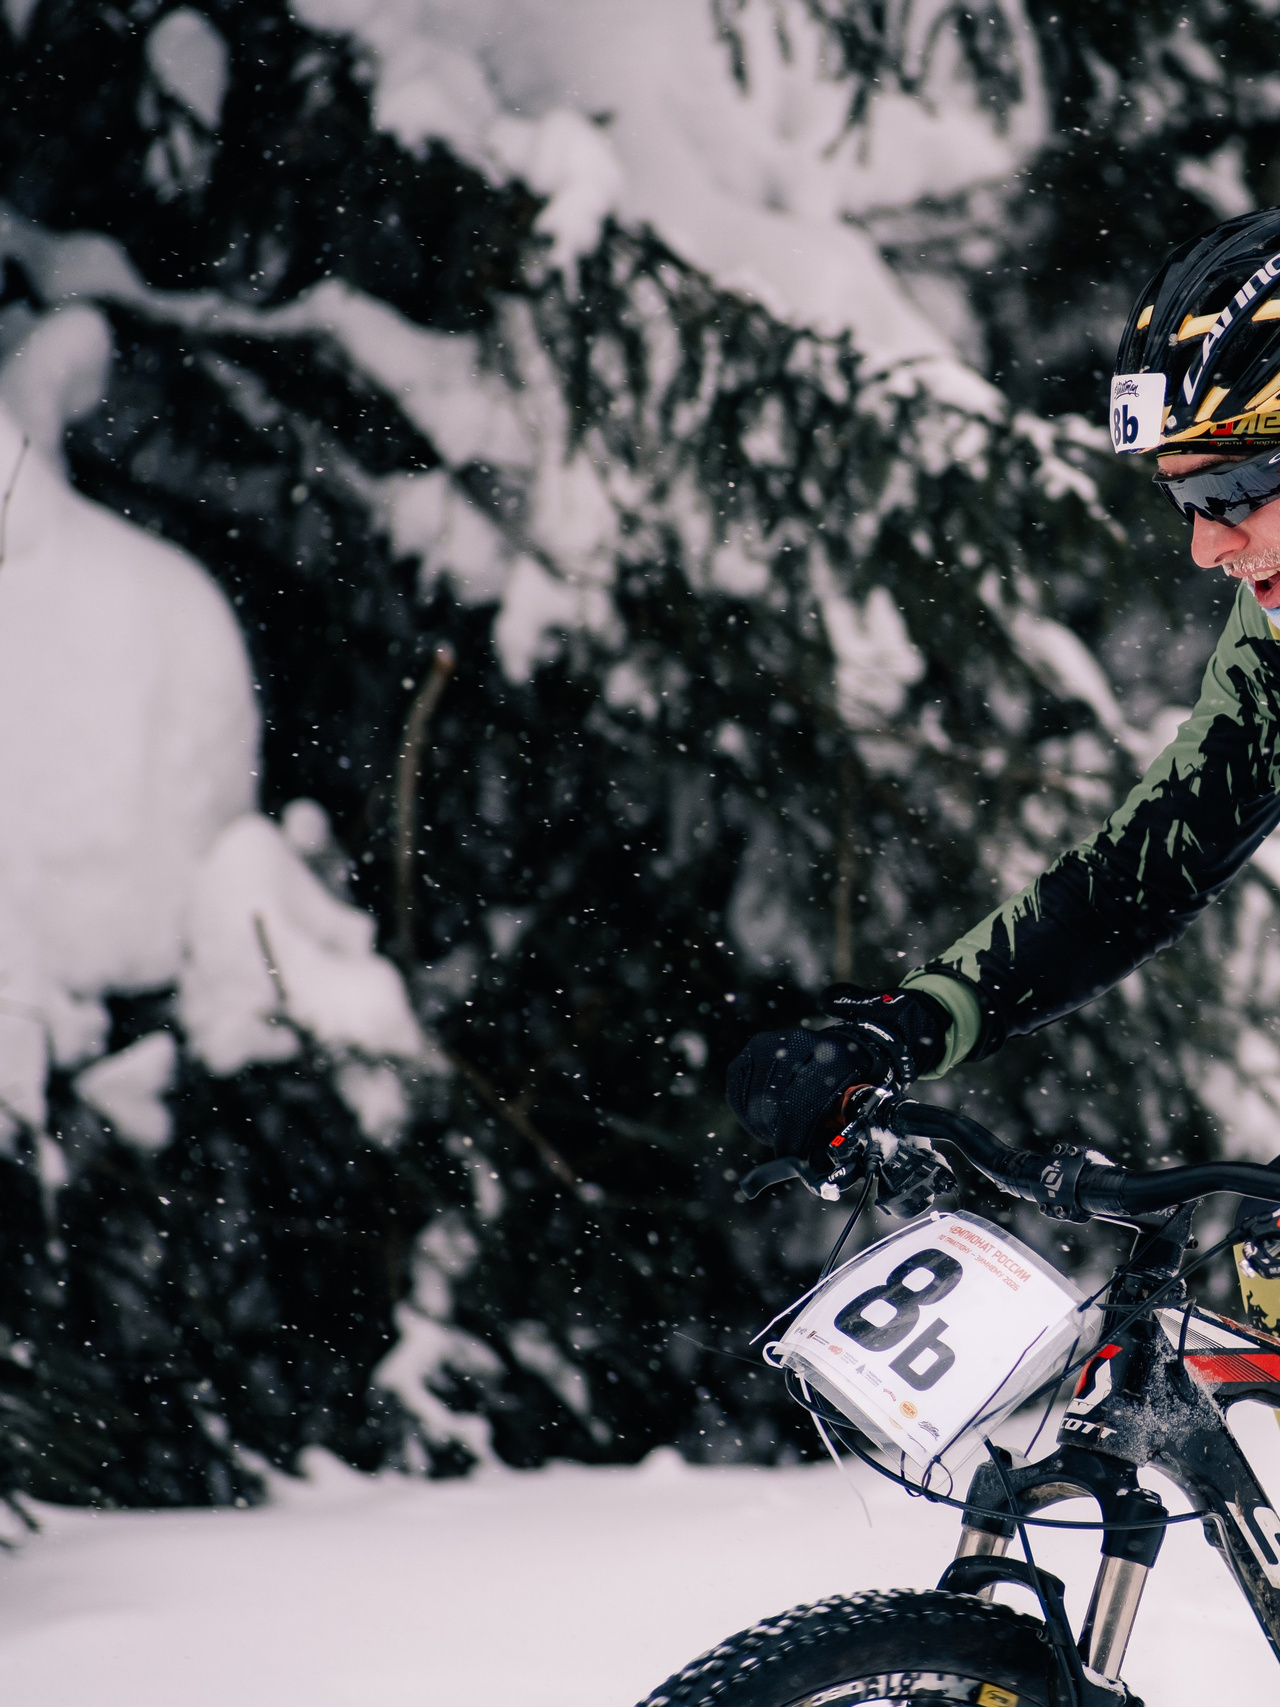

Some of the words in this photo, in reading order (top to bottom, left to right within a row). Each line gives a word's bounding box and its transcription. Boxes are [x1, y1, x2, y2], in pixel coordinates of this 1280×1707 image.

[1113, 404, 1138, 446] 8b
[949, 1224, 996, 1254] ЧЕМПИОНАТ
[992, 1249, 1032, 1283] РОССИИ
[834, 1248, 964, 1392] 8b
